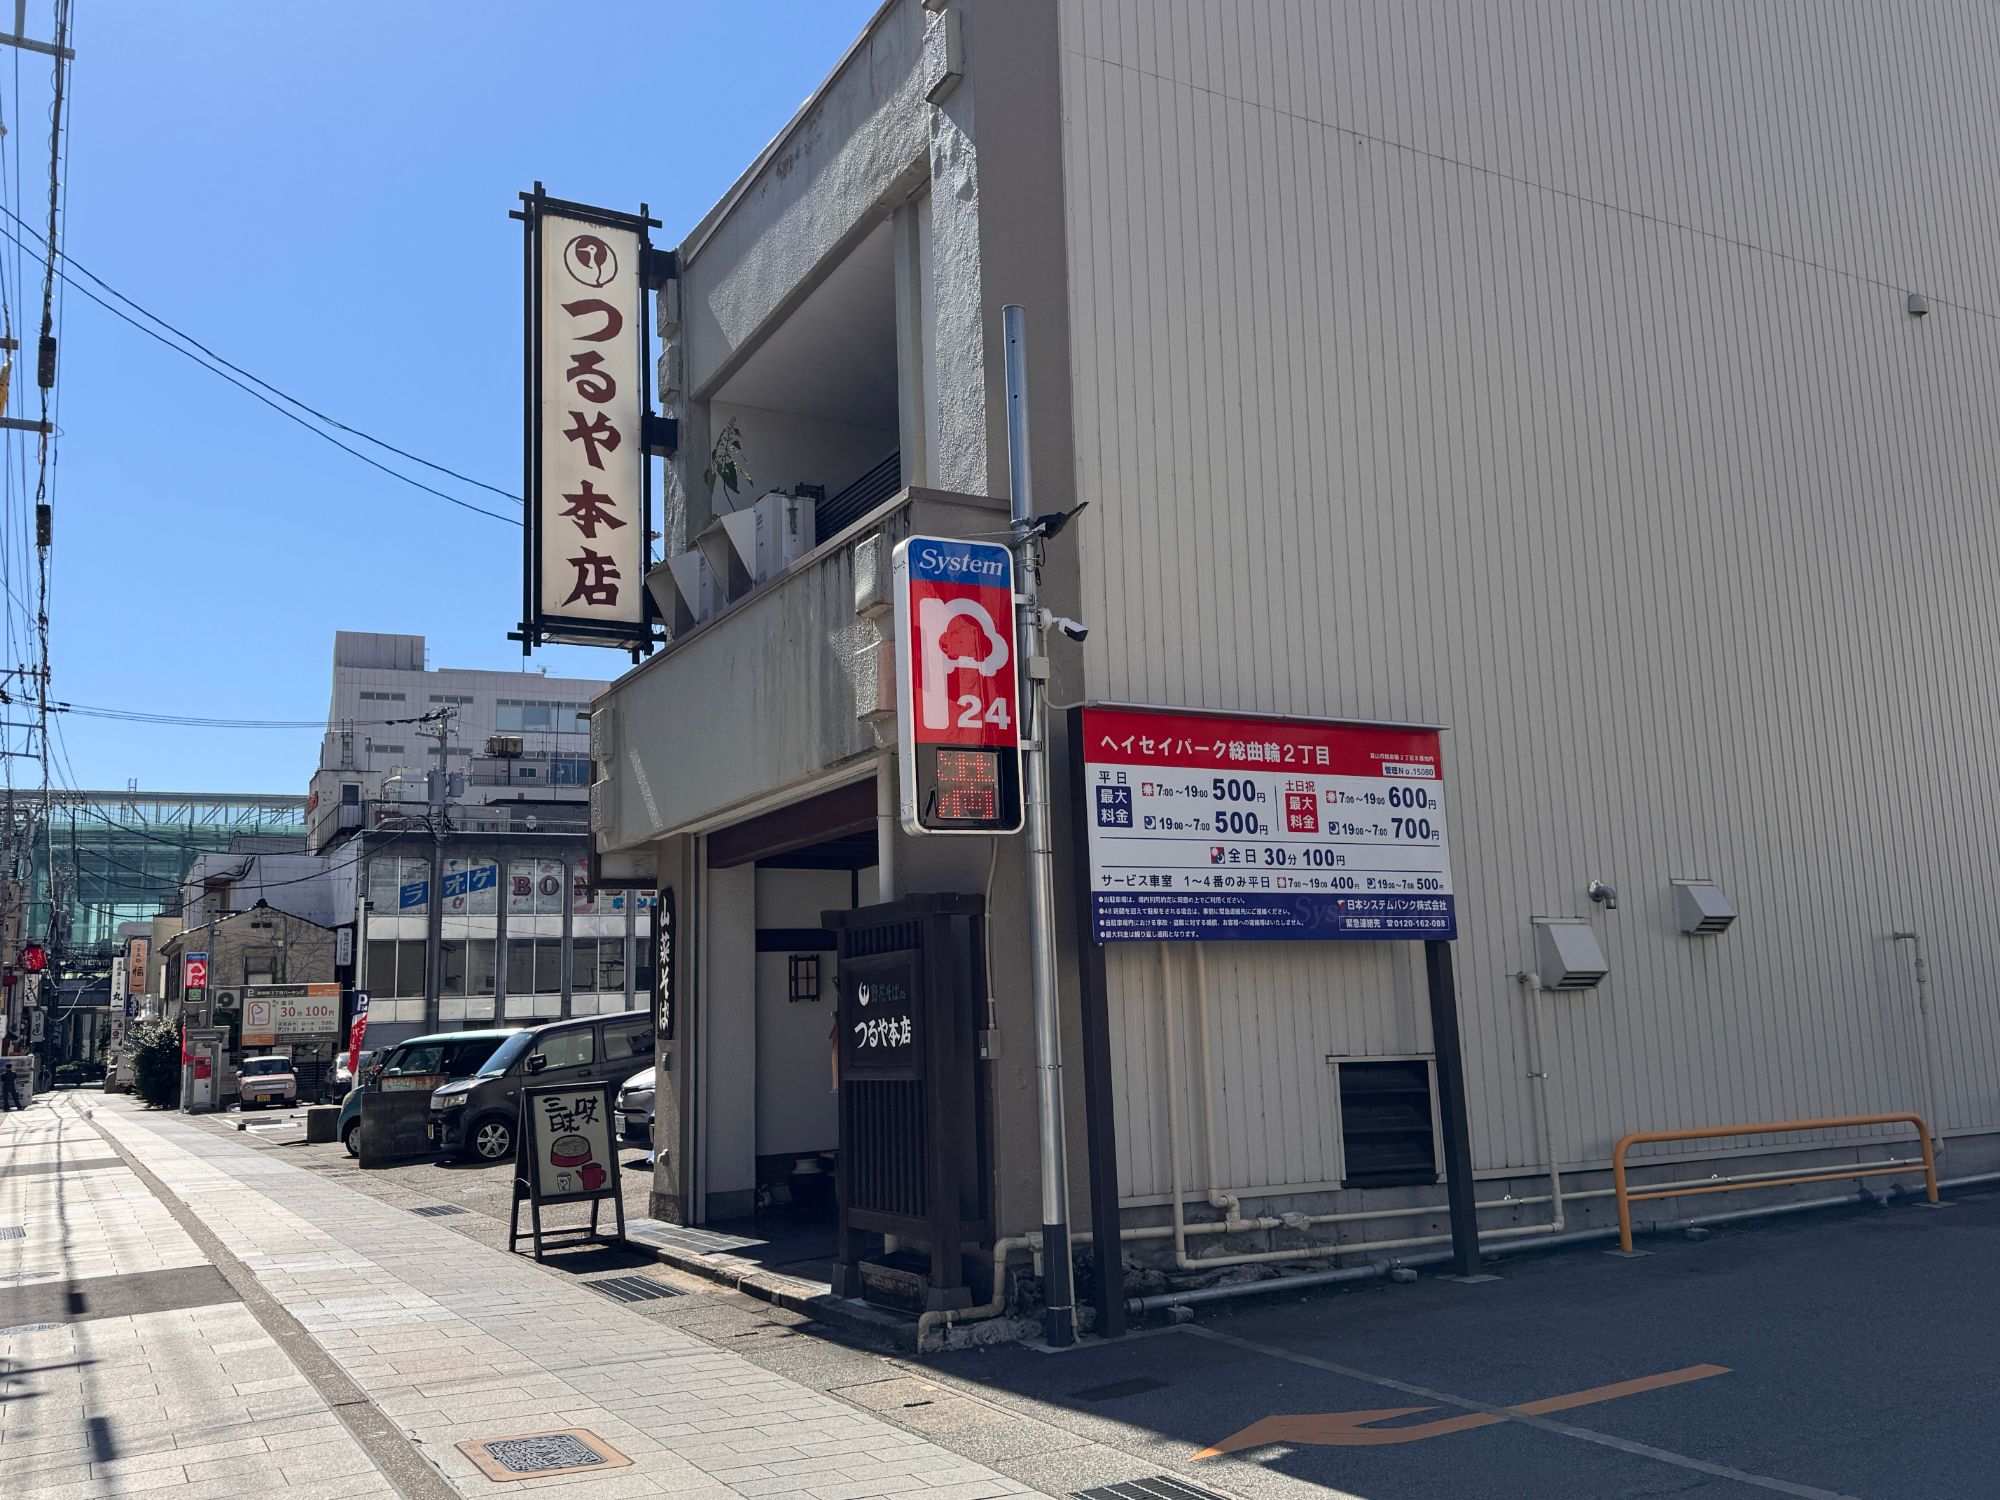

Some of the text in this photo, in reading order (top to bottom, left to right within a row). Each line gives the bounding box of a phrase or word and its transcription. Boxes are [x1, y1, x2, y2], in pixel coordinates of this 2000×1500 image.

[558, 298, 627, 608] つるや本店
[919, 548, 1004, 576] System
[1099, 770, 1127, 785] 平日
[1285, 779, 1315, 793] 土日祝
[1100, 788, 1128, 804] 最大
[1212, 778, 1266, 803] 500円
[1388, 786, 1437, 810] 600円
[1289, 795, 1313, 811] 最大
[1101, 808, 1129, 824] 料金
[1215, 810, 1269, 835] 500円
[1290, 814, 1315, 829] 料金
[1391, 817, 1440, 841] 700円
[1228, 848, 1346, 867] 全日 30分 100円
[1101, 873, 1173, 889] サービス車室
[1347, 899, 1448, 911] 日本システムバンク株式会社
[854, 1015, 912, 1049] つるや本店
